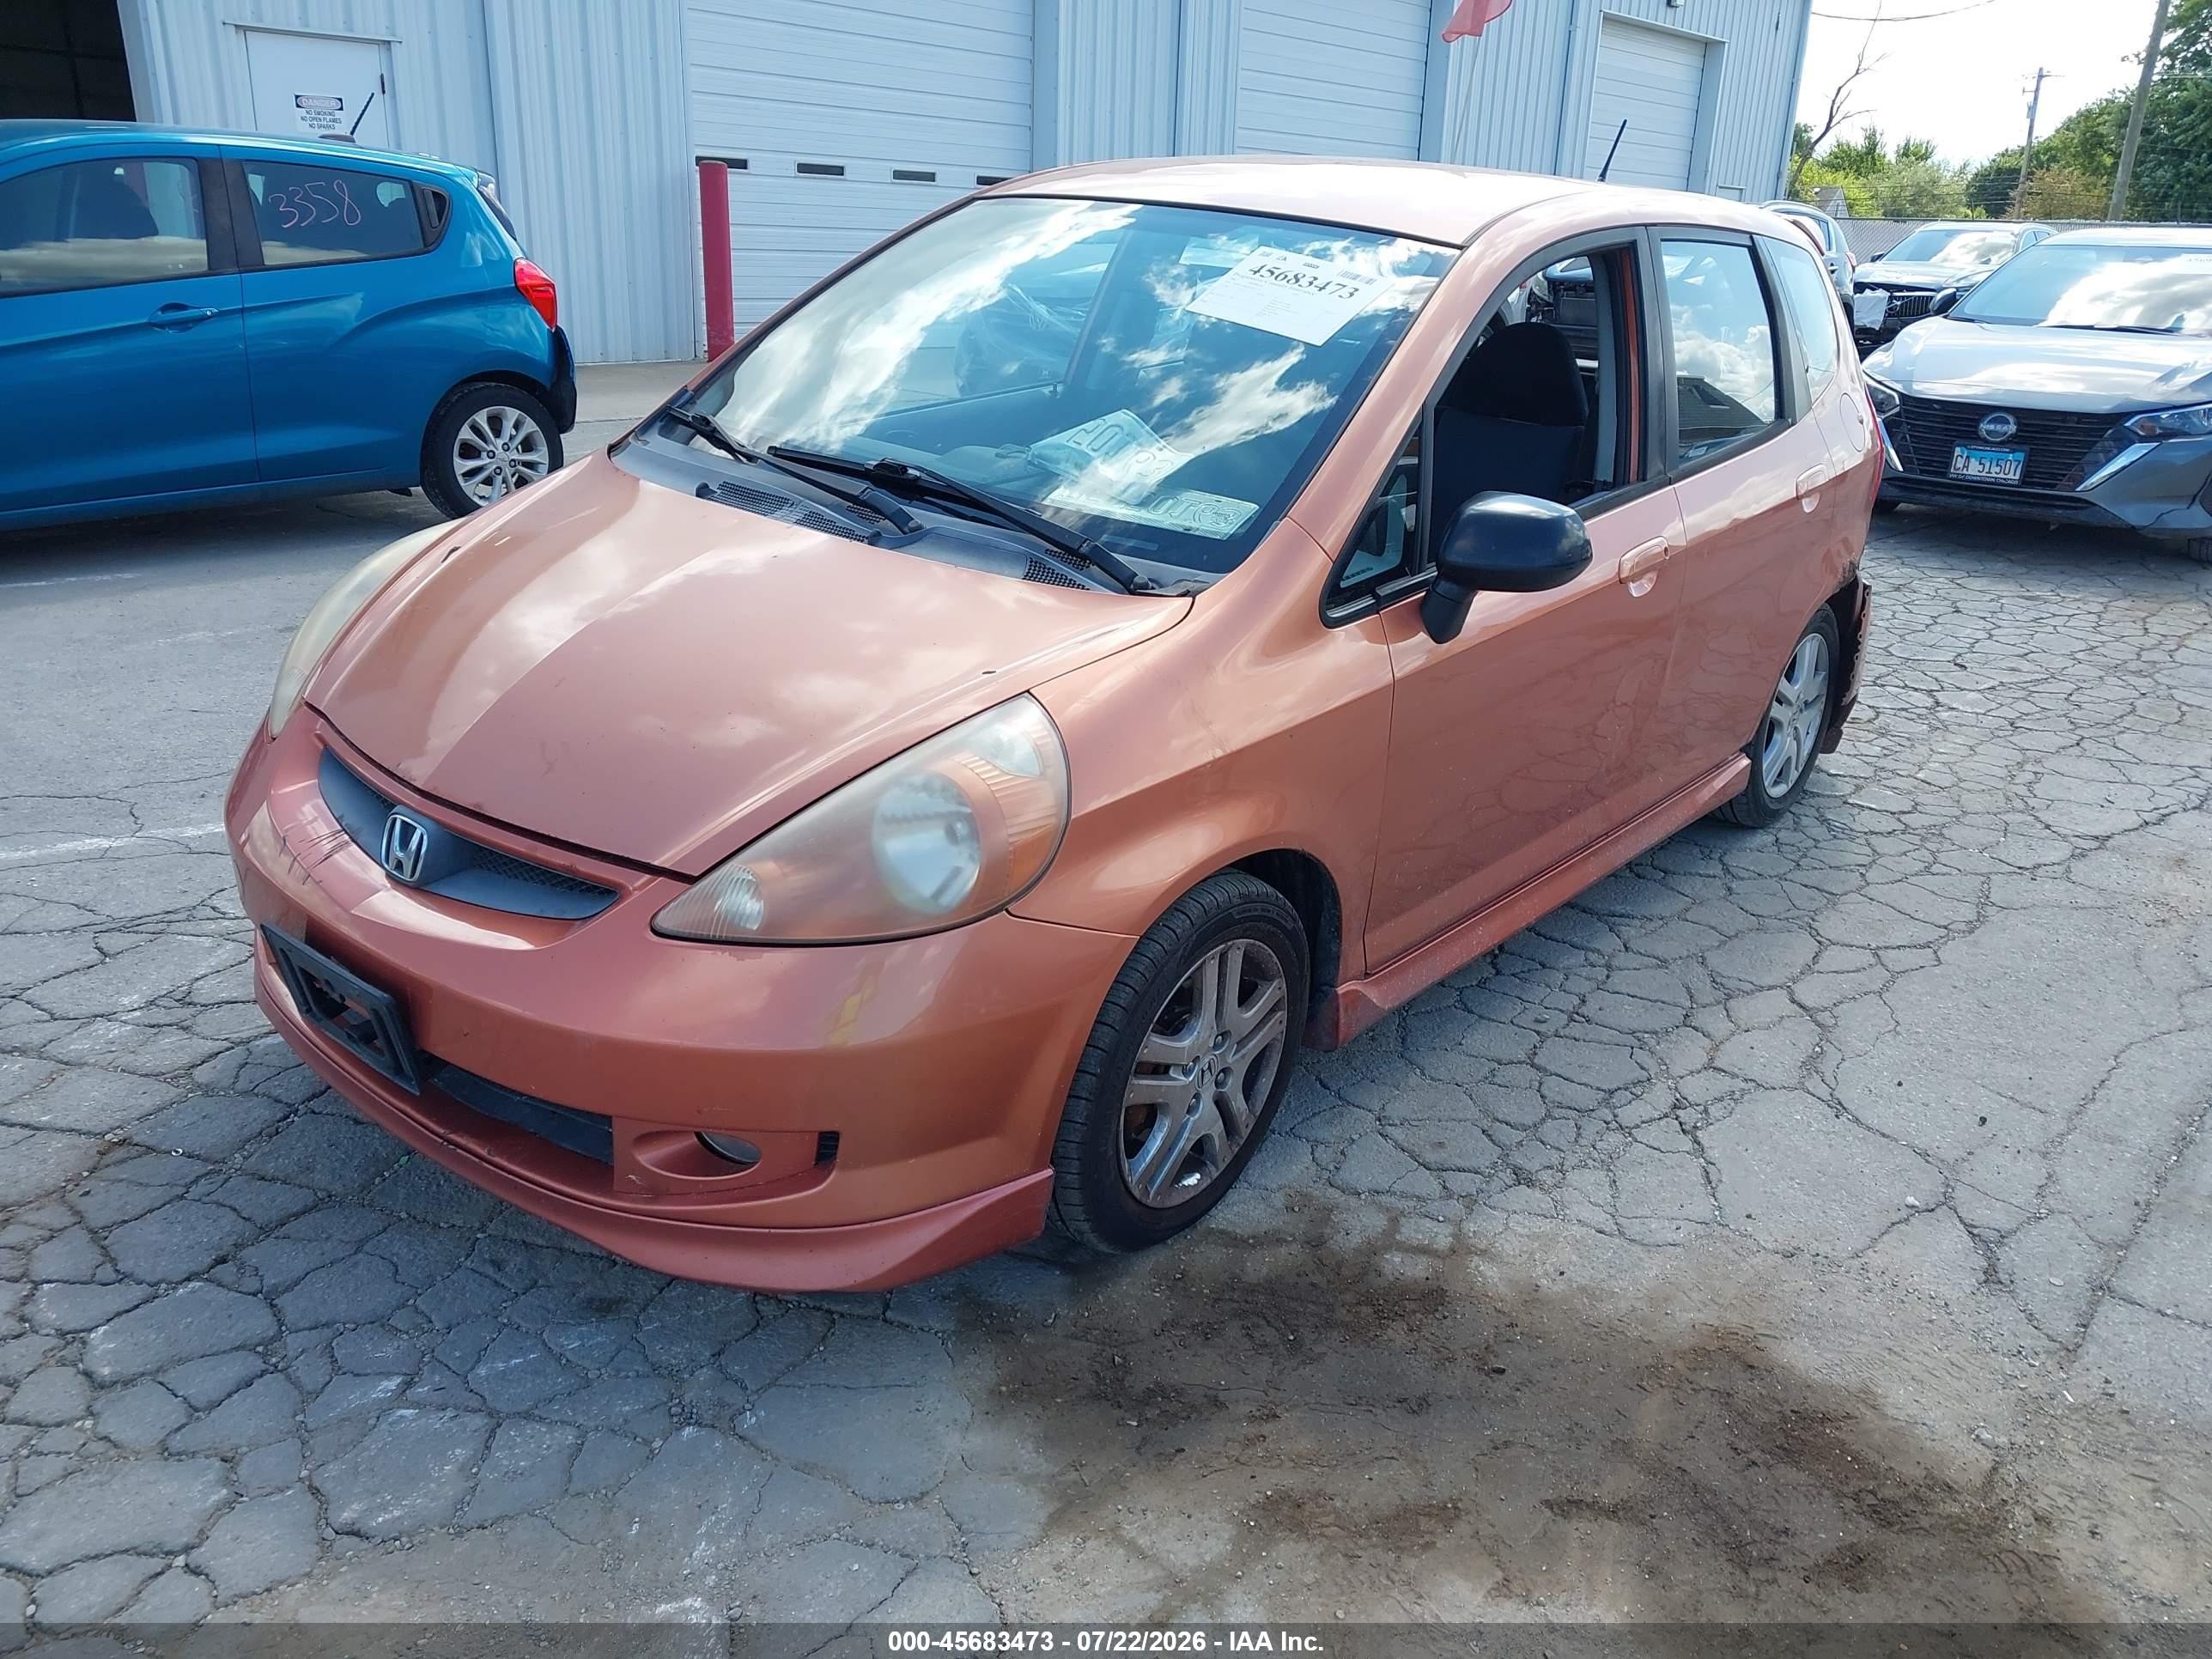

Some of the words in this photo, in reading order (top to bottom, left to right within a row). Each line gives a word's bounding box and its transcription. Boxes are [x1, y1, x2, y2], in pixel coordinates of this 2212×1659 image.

[268, 179, 362, 228] 3358
[1248, 264, 1360, 299] 45683473
[1979, 422, 2017, 433] NISSAN
[1954, 454, 1971, 471] CA
[1978, 456, 2022, 477] 51507
